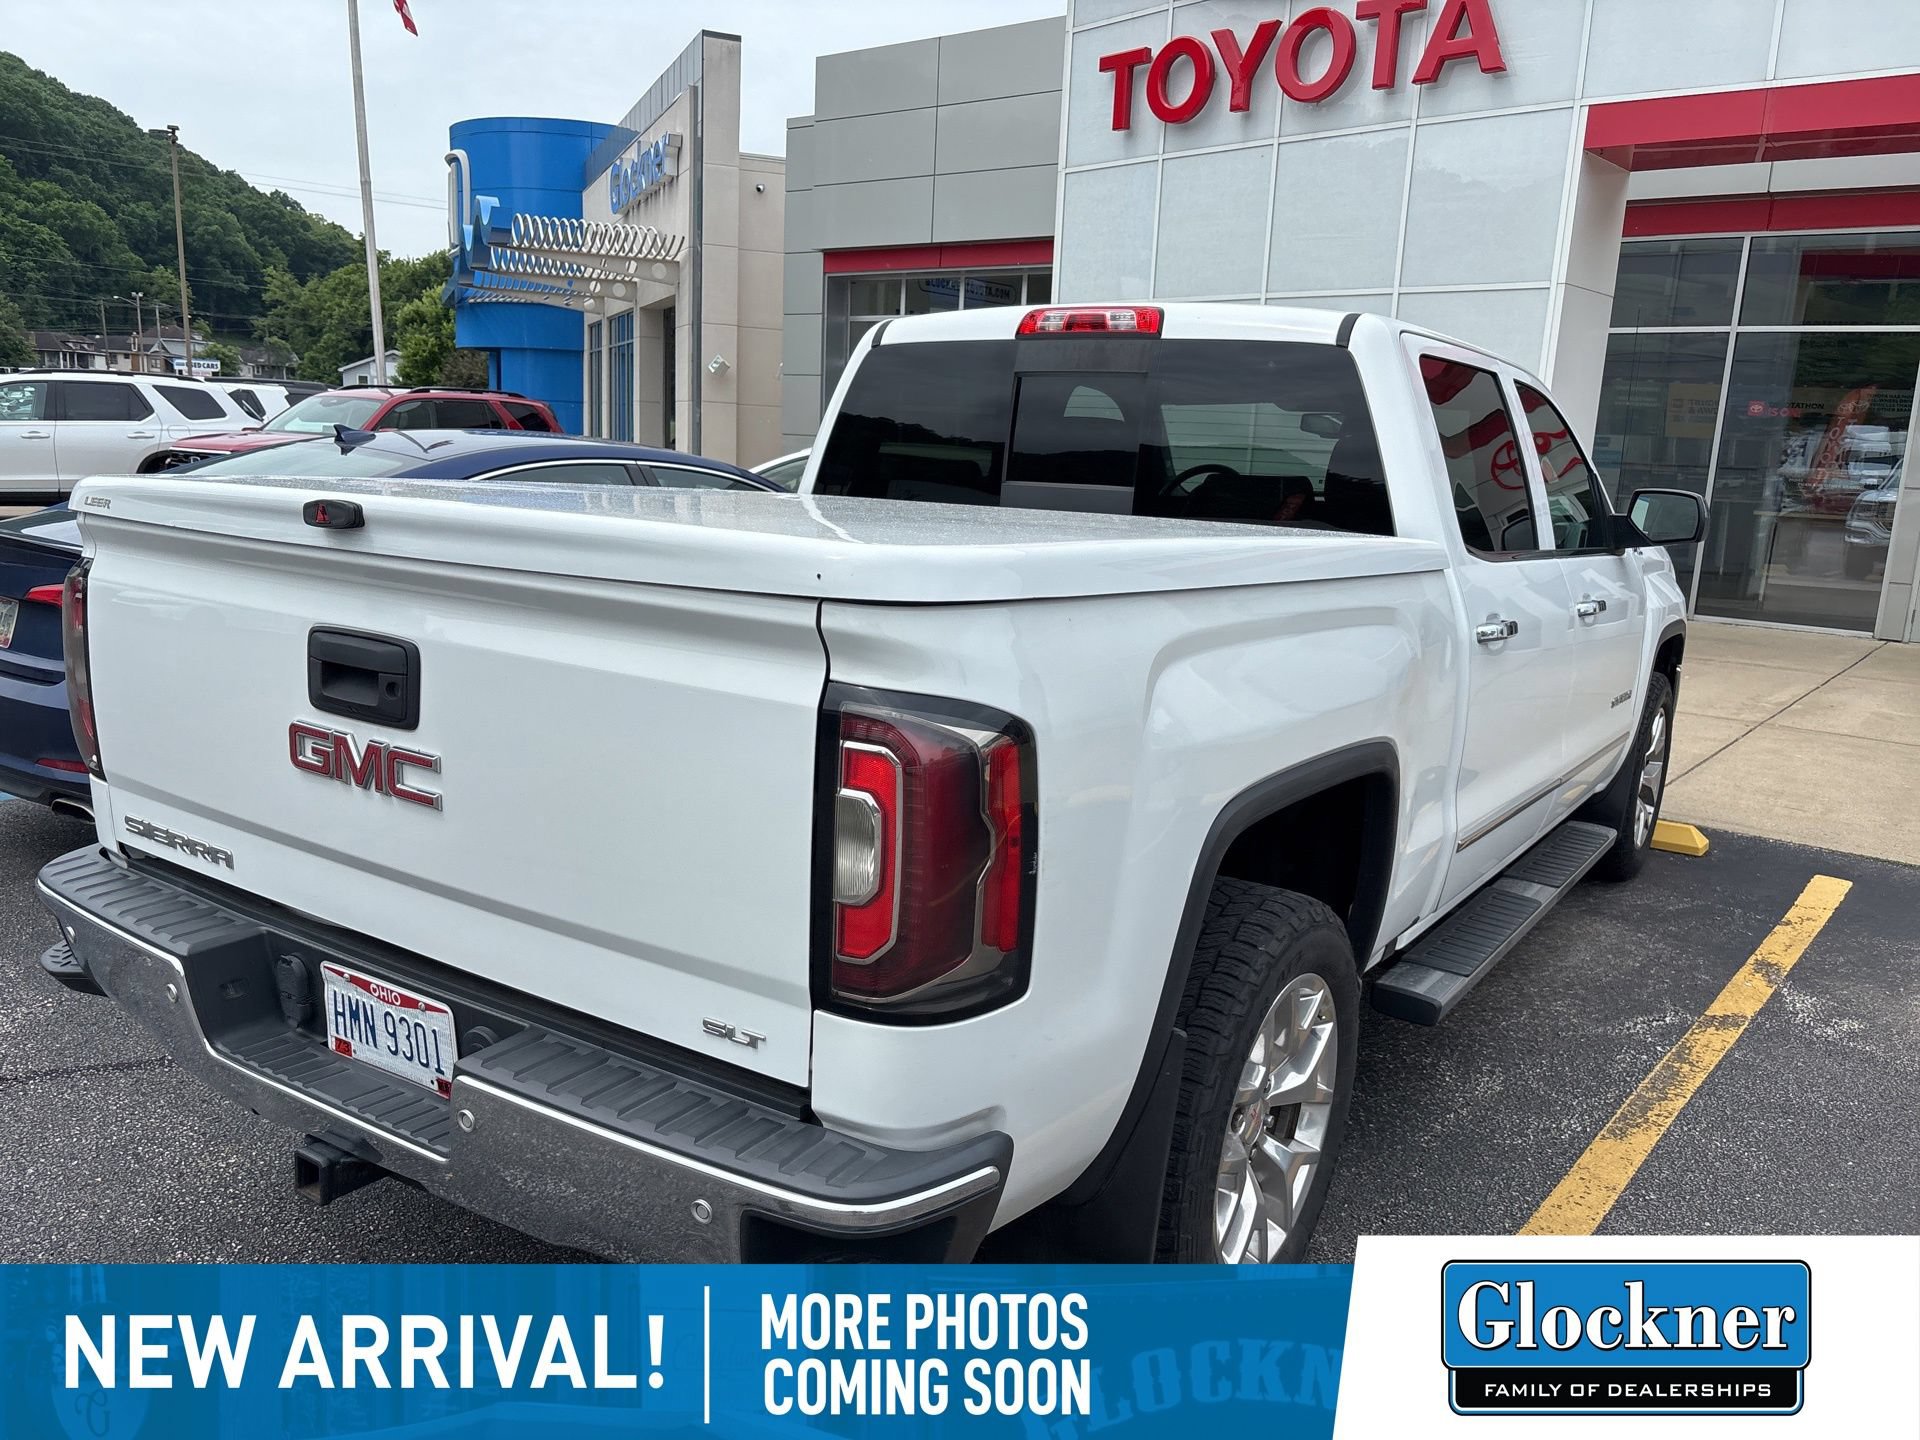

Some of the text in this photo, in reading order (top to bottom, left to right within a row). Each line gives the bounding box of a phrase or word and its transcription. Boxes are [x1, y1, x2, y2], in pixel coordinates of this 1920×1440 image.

[1099, 0, 1507, 131] TOYOTA
[202, 362, 219, 370] CARS
[84, 496, 111, 509] LEER
[289, 719, 444, 811] GMC
[124, 815, 235, 870] SIERRA
[369, 983, 401, 1006] OHIO
[333, 989, 379, 1049] HMN
[383, 1010, 445, 1076] 9301
[703, 1016, 766, 1049] SLT
